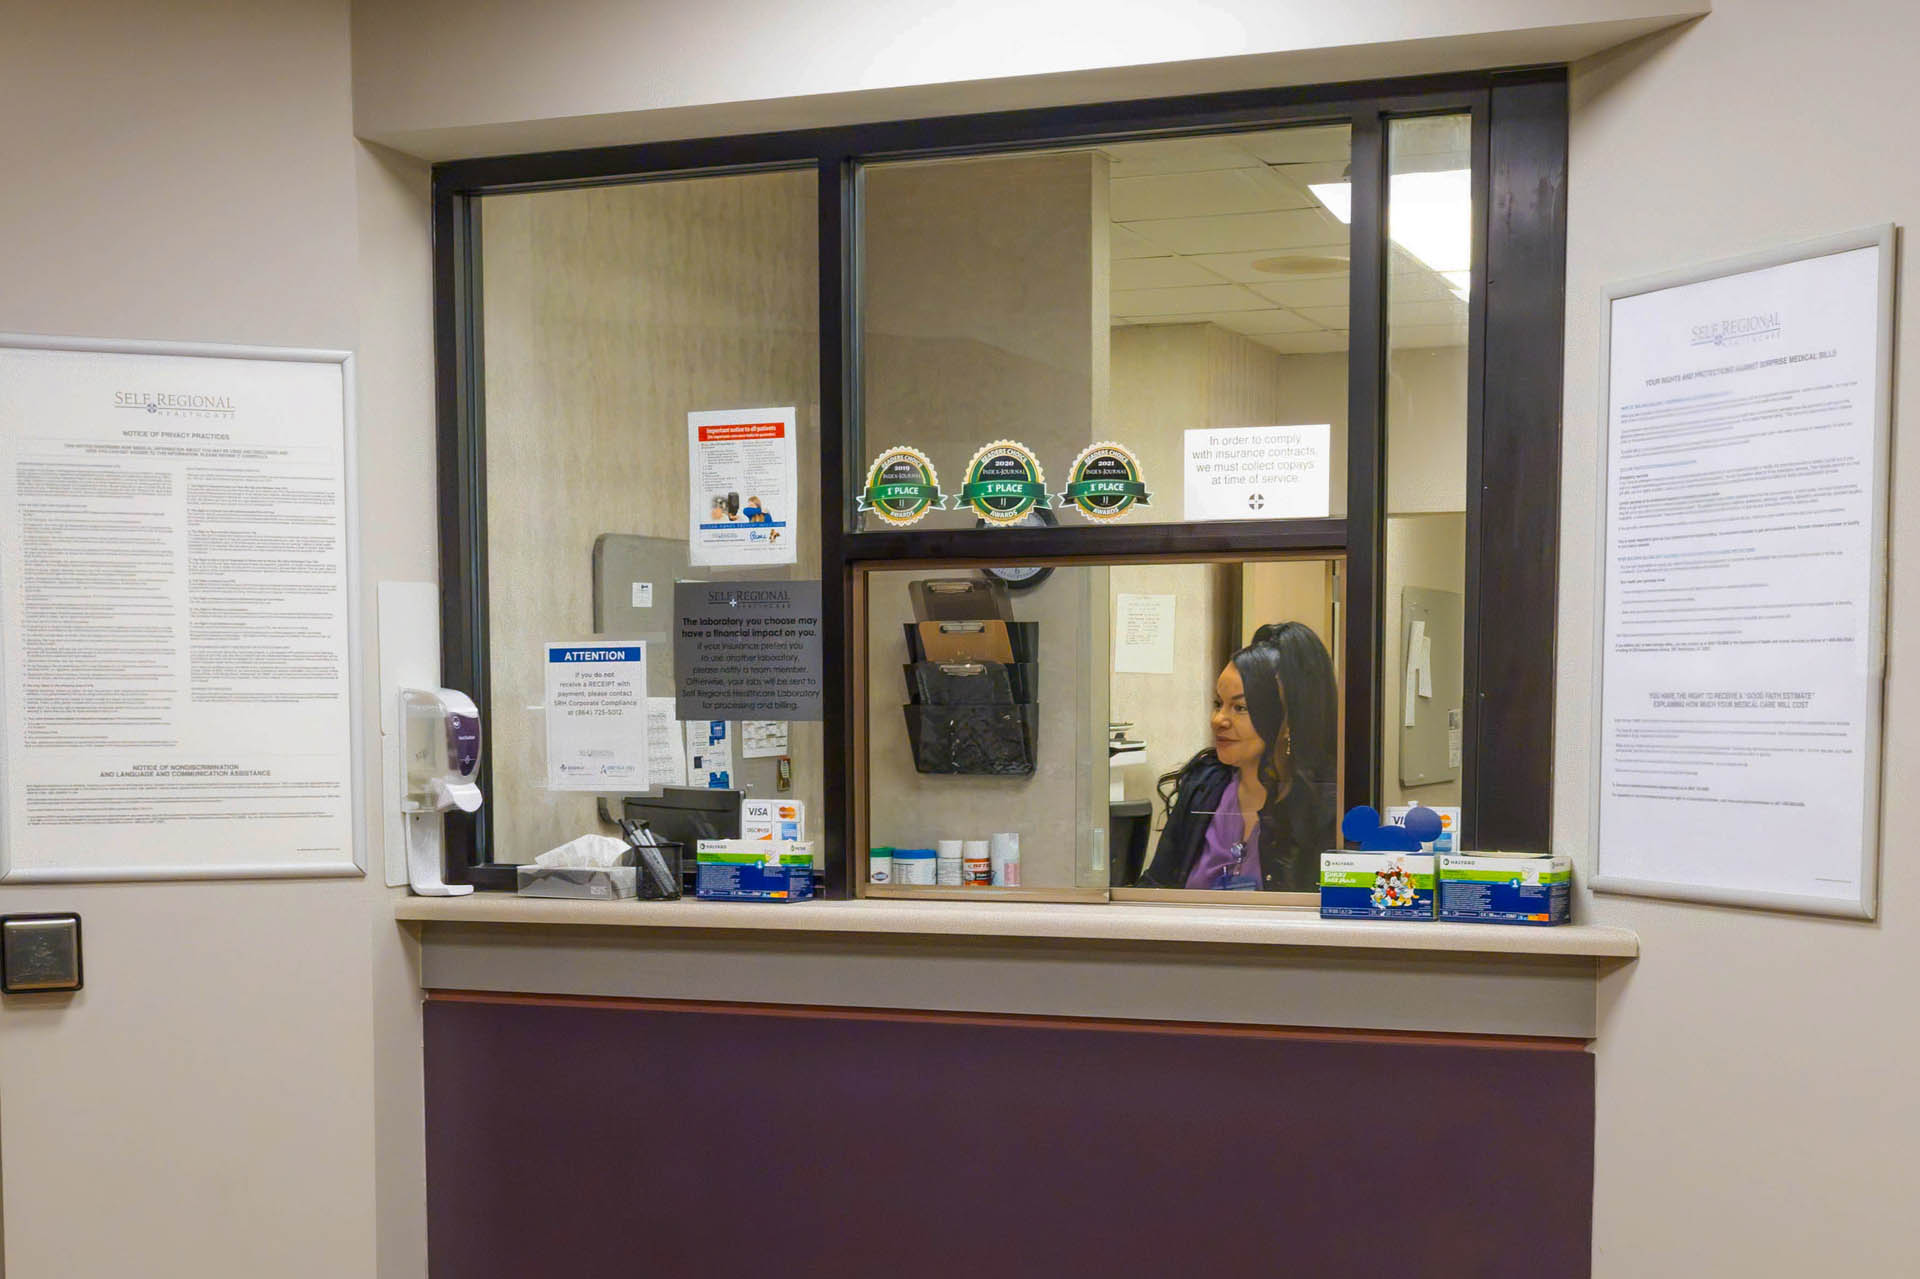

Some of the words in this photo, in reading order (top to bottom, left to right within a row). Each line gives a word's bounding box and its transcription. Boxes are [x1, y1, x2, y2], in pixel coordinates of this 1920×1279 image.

[1721, 312, 1781, 335] REGIONAL
[1645, 377, 1660, 387] YOUR
[1788, 352, 1817, 364] MEDICAL
[1818, 348, 1837, 360] BILLS
[114, 391, 151, 405] SELF
[157, 392, 235, 409] REGIONAL
[160, 432, 190, 440] PRIVACY
[192, 432, 230, 440] PRACTICES
[1210, 436, 1219, 446] In
[1222, 435, 1248, 446] order
[1252, 435, 1260, 444] to
[1264, 434, 1301, 446] comply
[1192, 449, 1212, 459] with
[1216, 448, 1264, 458] insurance
[1196, 464, 1210, 472] we
[1214, 462, 1238, 472] must
[1242, 461, 1274, 471] collect
[1277, 461, 1314, 472] copays
[1211, 476, 1221, 485] at
[1224, 474, 1246, 484] time
[1249, 474, 1258, 484] of
[996, 484, 1023, 492] PLACE
[708, 591, 733, 600] SELF
[736, 591, 791, 600] REGIONAL
[700, 617, 743, 626] laboratory
[799, 618, 817, 626] may
[682, 629, 703, 638] have
[714, 629, 750, 637] financial
[752, 629, 782, 639] impact
[798, 630, 816, 638] you.
[761, 642, 788, 650] prefers
[564, 651, 625, 661] ATTENTION
[698, 690, 732, 698] Regional
[777, 690, 819, 698] Laboratory
[714, 702, 756, 710] processing
[748, 808, 768, 816] VISA
